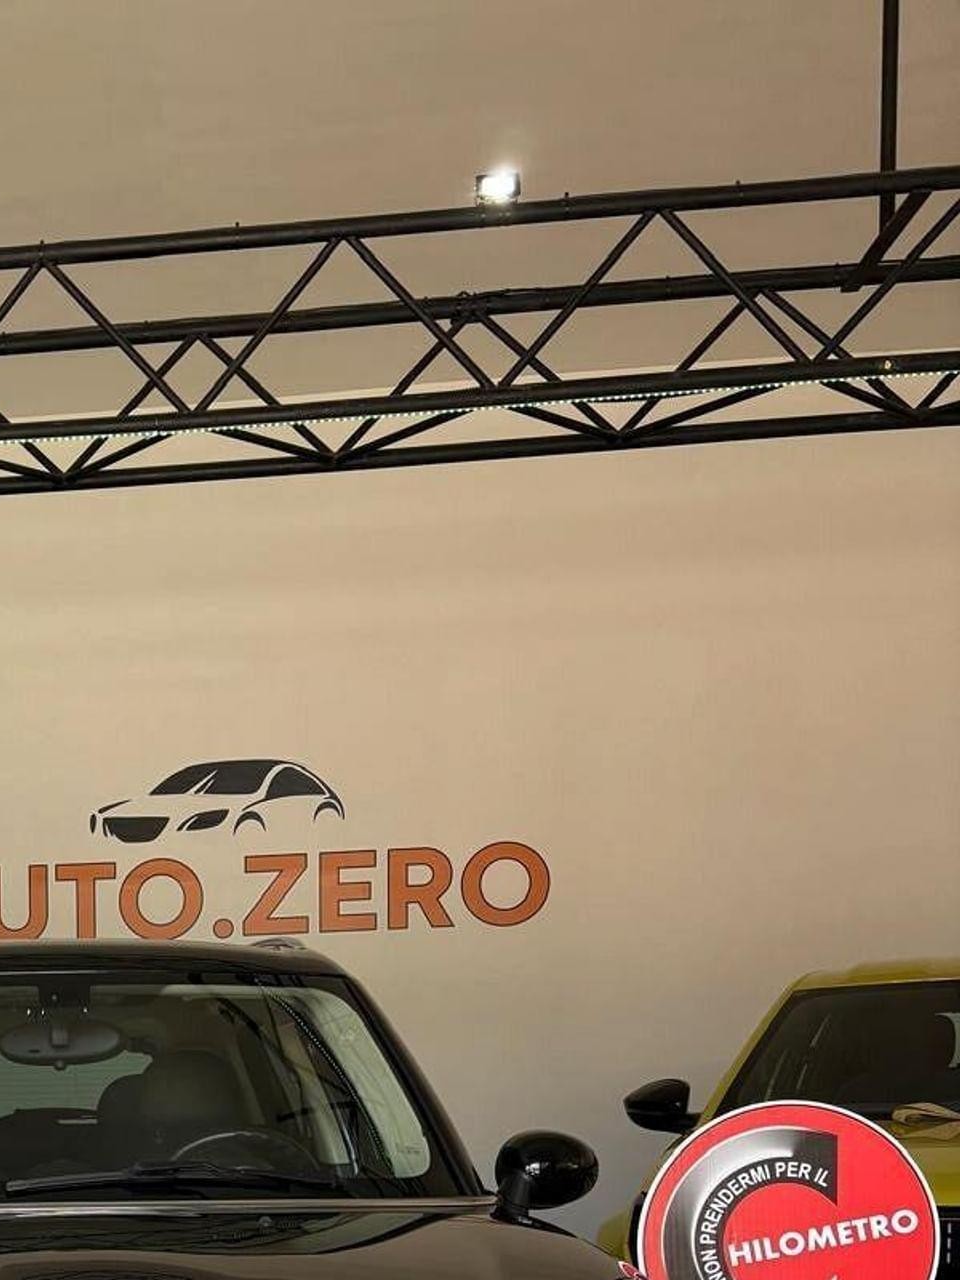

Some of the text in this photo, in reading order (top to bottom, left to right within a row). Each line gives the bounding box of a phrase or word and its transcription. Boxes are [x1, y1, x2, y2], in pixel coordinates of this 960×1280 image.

[700, 1165, 771, 1246] PRENDERMI
[775, 1162, 811, 1180] PER
[814, 1168, 828, 1188] IL
